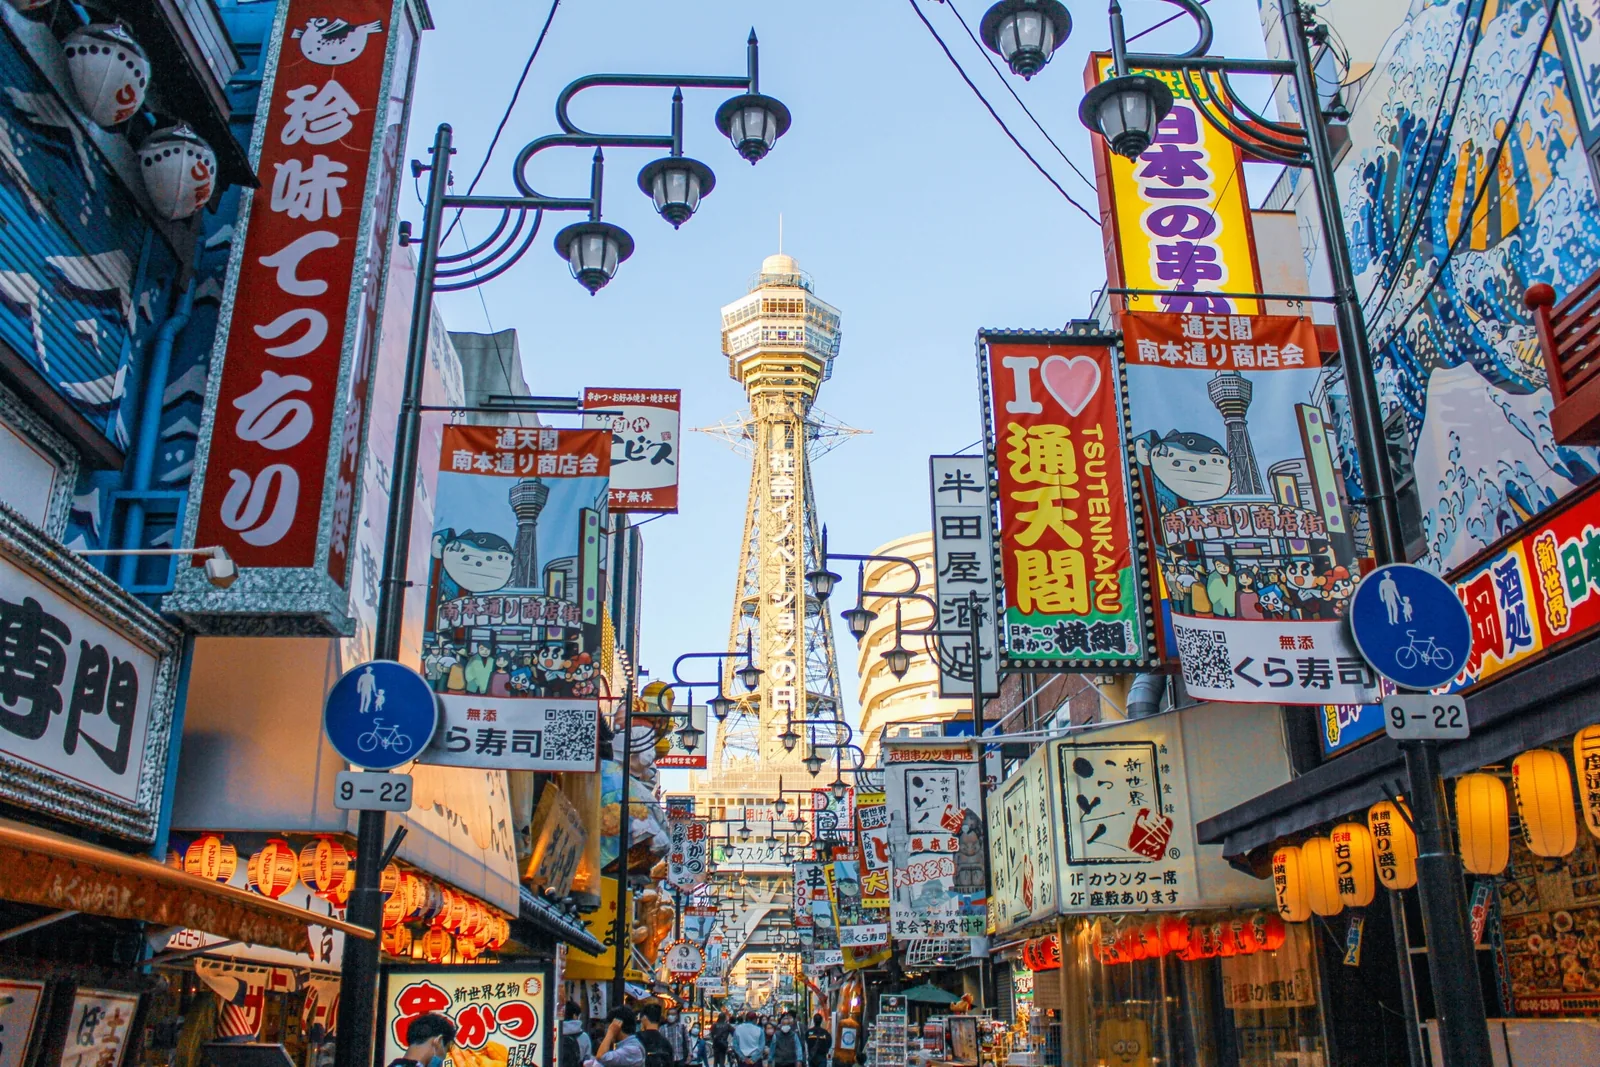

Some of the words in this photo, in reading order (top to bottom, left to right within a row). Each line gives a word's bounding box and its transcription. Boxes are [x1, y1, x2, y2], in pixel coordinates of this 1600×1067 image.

[219, 79, 361, 547] 珍味てつちり
[1181, 315, 1252, 341] 通天閣
[1136, 339, 1305, 368] 南本通り商店会
[1002, 356, 1043, 414] I
[496, 428, 558, 451] 通天閣
[451, 449, 600, 475] 南本通り商店会
[1006, 421, 1089, 615] 通天閣
[1082, 423, 1122, 614] TSUTENKAKU
[1165, 508, 1326, 537] 南本通り商店街
[768, 450, 797, 740] 社会イノベーションの日
[1537, 534, 1568, 630] 新世界
[441, 601, 581, 624] 南本通り商店街
[1495, 556, 1532, 653] 酒処
[1011, 626, 1053, 636] 日本一の
[1013, 639, 1054, 651] 串かつ
[1054, 620, 1127, 654] 横綱
[1279, 635, 1314, 650] 無添
[1234, 656, 1376, 689] くら寿司
[467, 708, 497, 722] 無添
[889, 750, 973, 760] 元祖串カツ専門店
[1124, 757, 1149, 807] 新世界
[861, 806, 887, 818] 新世界
[692, 823, 710, 873] 串かつ
[1333, 832, 1351, 842] 元祖
[207, 845, 216, 876] アサヒビール
[319, 849, 327, 881] アサヒビール
[1374, 823, 1396, 881] 握り盛り
[262, 853, 273, 884] アサヒビール
[893, 857, 956, 887] 大阪名物
[1070, 873, 1083, 886] 1F
[1089, 871, 1177, 887] カウンター席
[1336, 844, 1356, 894] もつ鍋
[1070, 892, 1085, 905] 2F
[1090, 889, 1178, 906] 座敷あります
[854, 933, 887, 942] くら寿司
[896, 919, 984, 934] 宴会予約受付中
[453, 983, 520, 1002] 新世界名物
